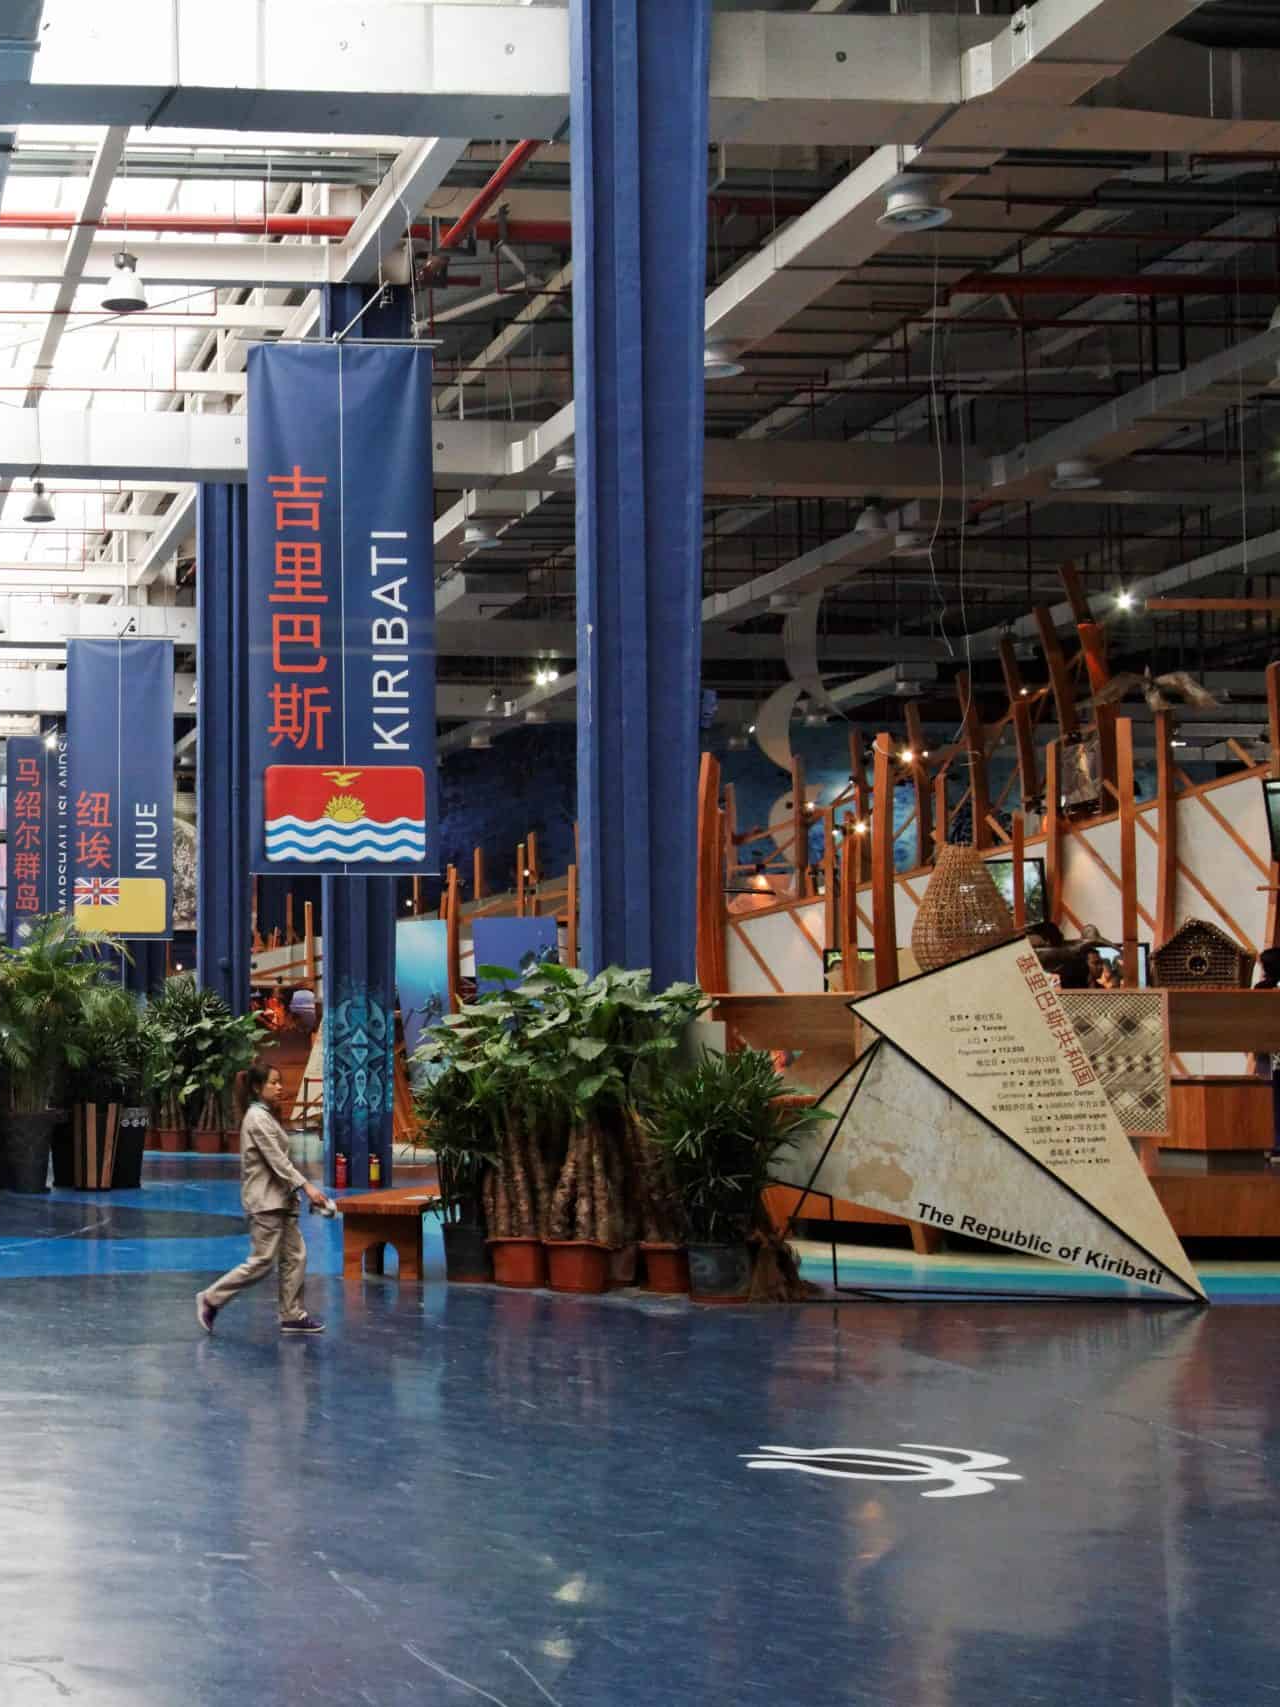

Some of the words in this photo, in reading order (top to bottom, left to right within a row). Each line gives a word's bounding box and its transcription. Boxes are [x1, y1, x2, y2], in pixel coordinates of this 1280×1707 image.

[267, 464, 331, 750] 吉里巴斯
[370, 530, 410, 750] KIRIBATI
[13, 757, 41, 912] 马绍尔群岛
[75, 791, 113, 870] 纽埃
[135, 803, 157, 870] NIUE
[1014, 951, 1096, 1088] 基里巴斯共和国
[918, 1202, 954, 1229] The
[960, 1214, 1052, 1255] Republic
[1058, 1244, 1082, 1263] of
[1085, 1251, 1164, 1286] Kiribati
